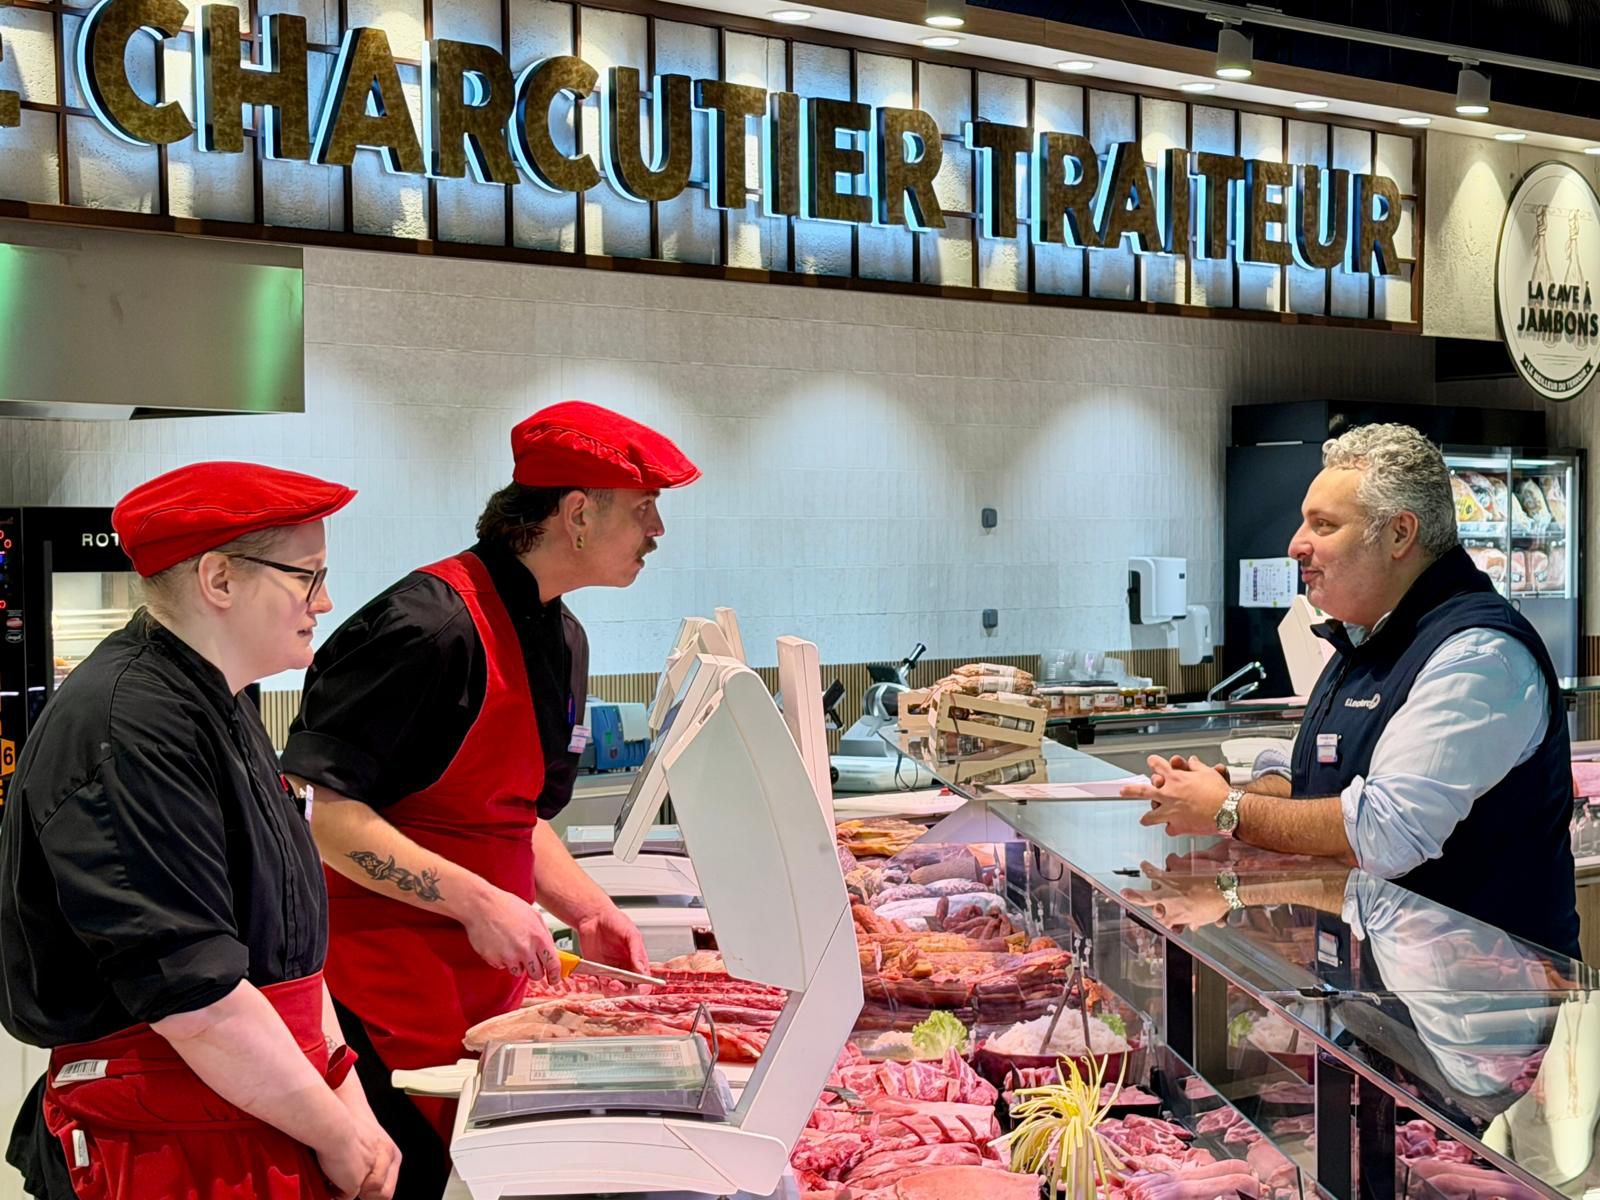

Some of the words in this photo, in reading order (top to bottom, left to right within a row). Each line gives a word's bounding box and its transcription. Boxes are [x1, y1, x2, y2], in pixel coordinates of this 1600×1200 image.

[83, 0, 947, 230] CHARCUTIER
[968, 120, 1402, 276] TRAITEUR
[1528, 281, 1544, 300] LA
[1548, 283, 1579, 303] CAVE
[1517, 307, 1599, 337] JAMBONS
